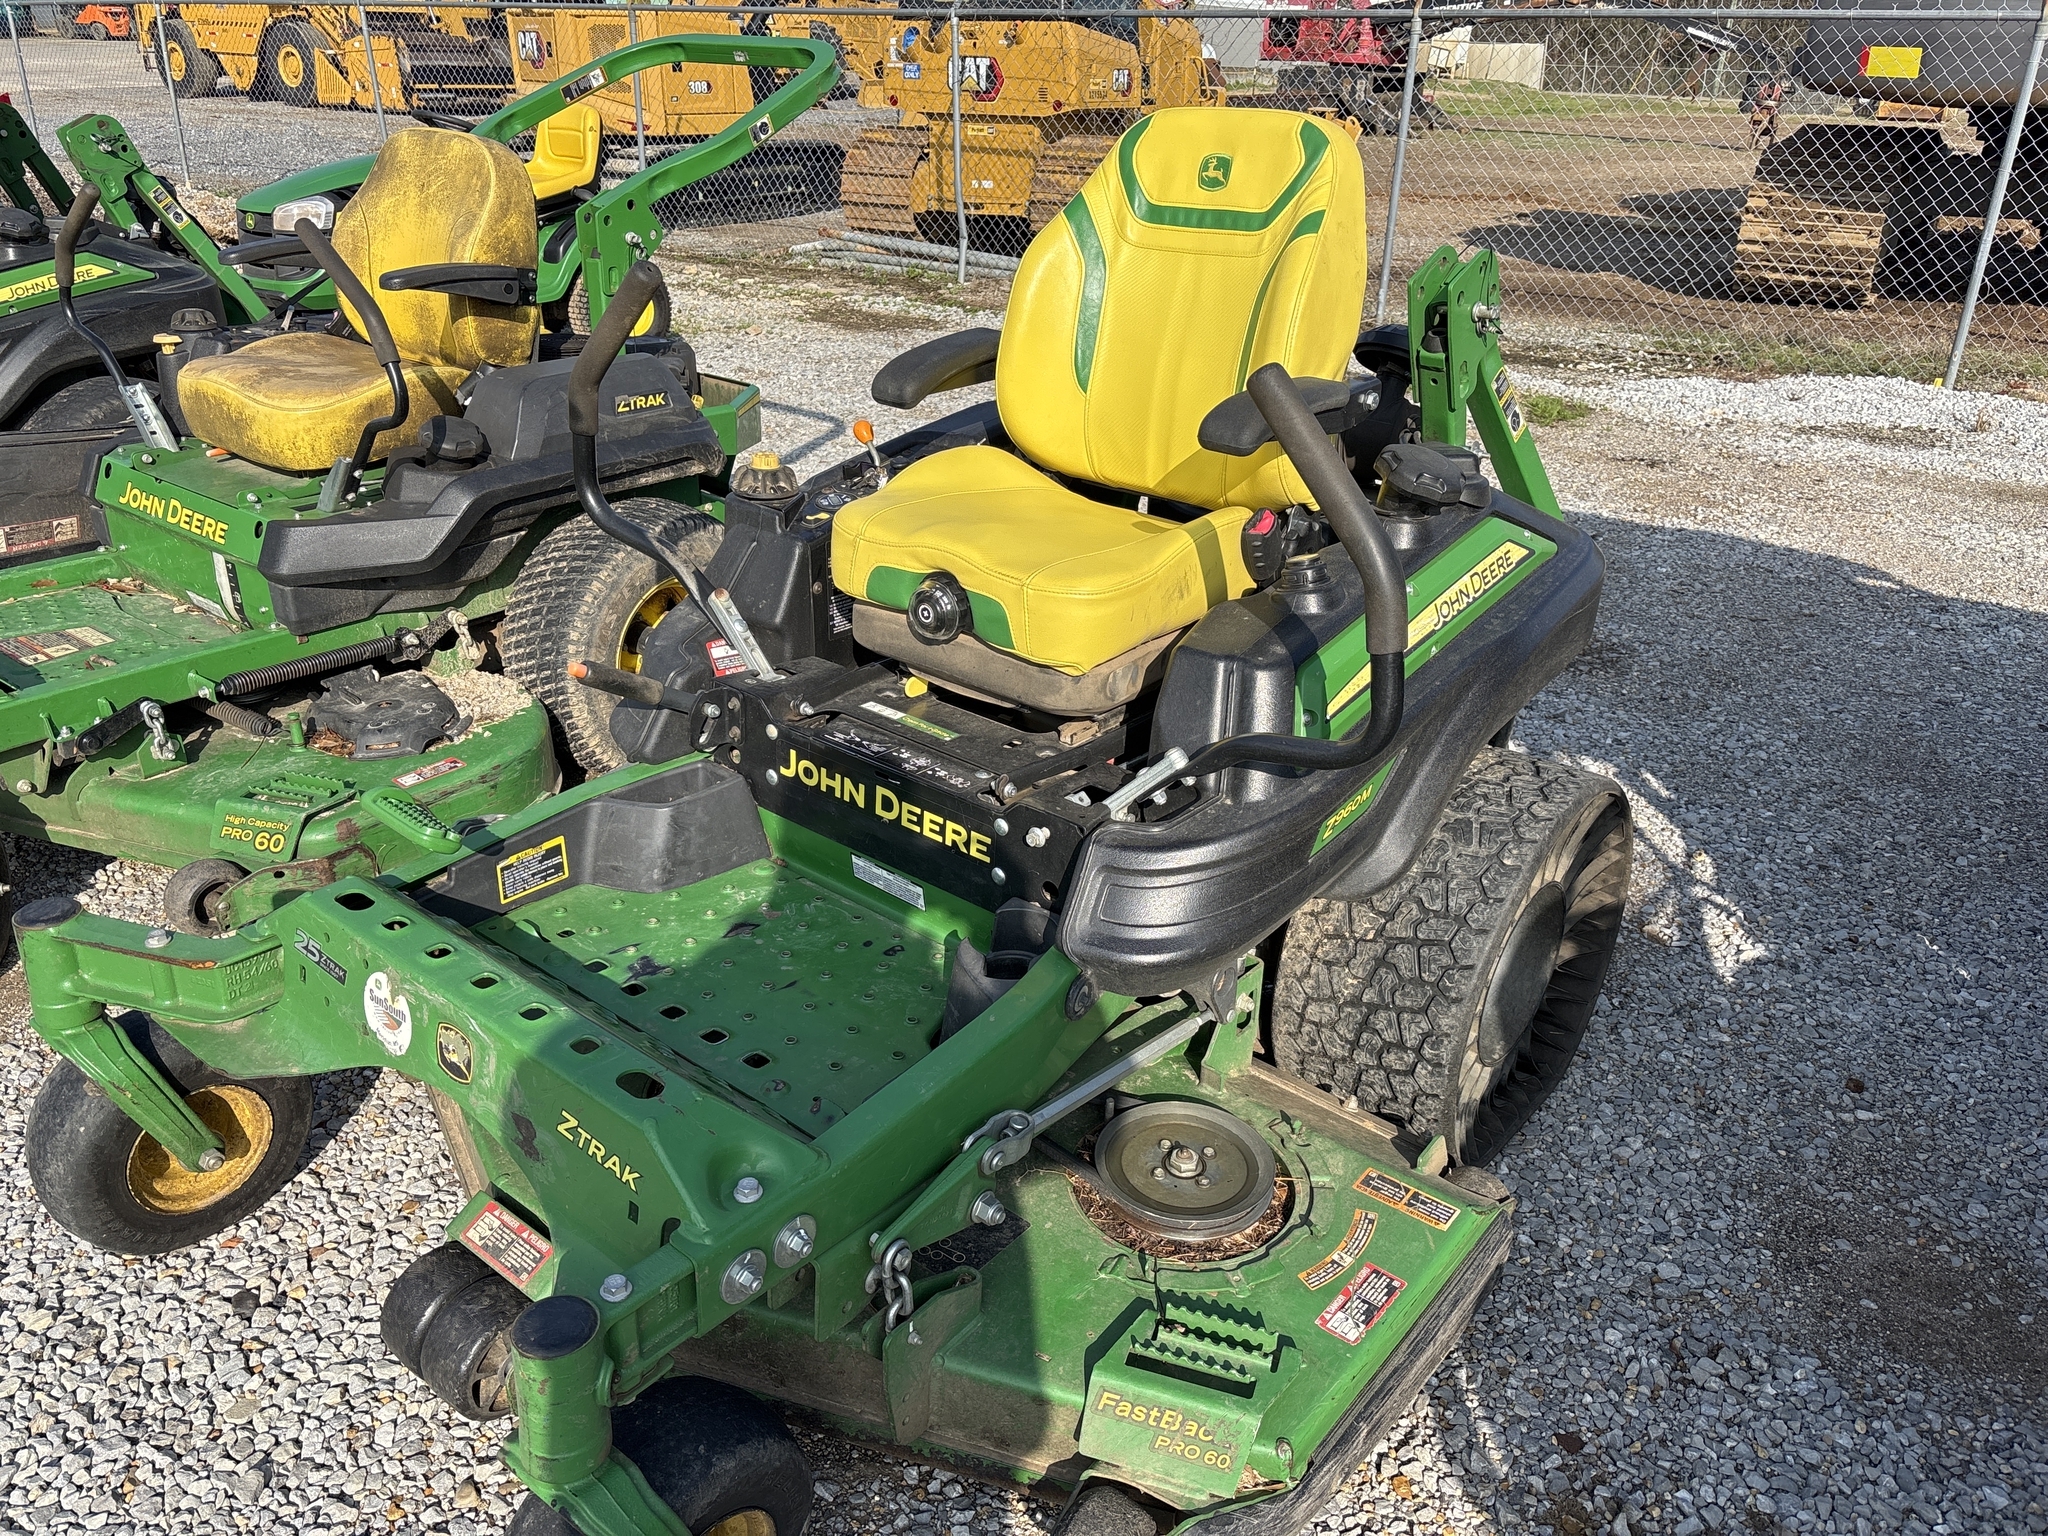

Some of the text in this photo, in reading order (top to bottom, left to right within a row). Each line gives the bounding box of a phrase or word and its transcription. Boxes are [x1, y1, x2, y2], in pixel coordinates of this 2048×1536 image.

[517, 31, 538, 60] CAT
[688, 81, 708, 94] 308
[1112, 69, 1129, 91] CAT
[8, 268, 95, 299] JOHN DRE
[118, 481, 229, 545] JOHN DEERE
[1433, 549, 1515, 628] JOHN DEERE
[780, 748, 865, 809] JOHN
[875, 785, 992, 864] DEERE
[1322, 783, 1374, 840] Z960M
[225, 814, 290, 832] High Capacity
[220, 826, 286, 853] PRO 60
[293, 928, 322, 962] 25
[320, 954, 347, 980] ZTRAK
[369, 988, 407, 1023] SunSouth
[556, 1109, 642, 1194] ZTRAK
[499, 1211, 520, 1230] DANGER
[528, 1234, 550, 1253] PELIGRO
[1327, 1294, 1347, 1313] DANGER
[1098, 1391, 1222, 1444] FastBac
[1154, 1435, 1231, 1470] PRO 60
